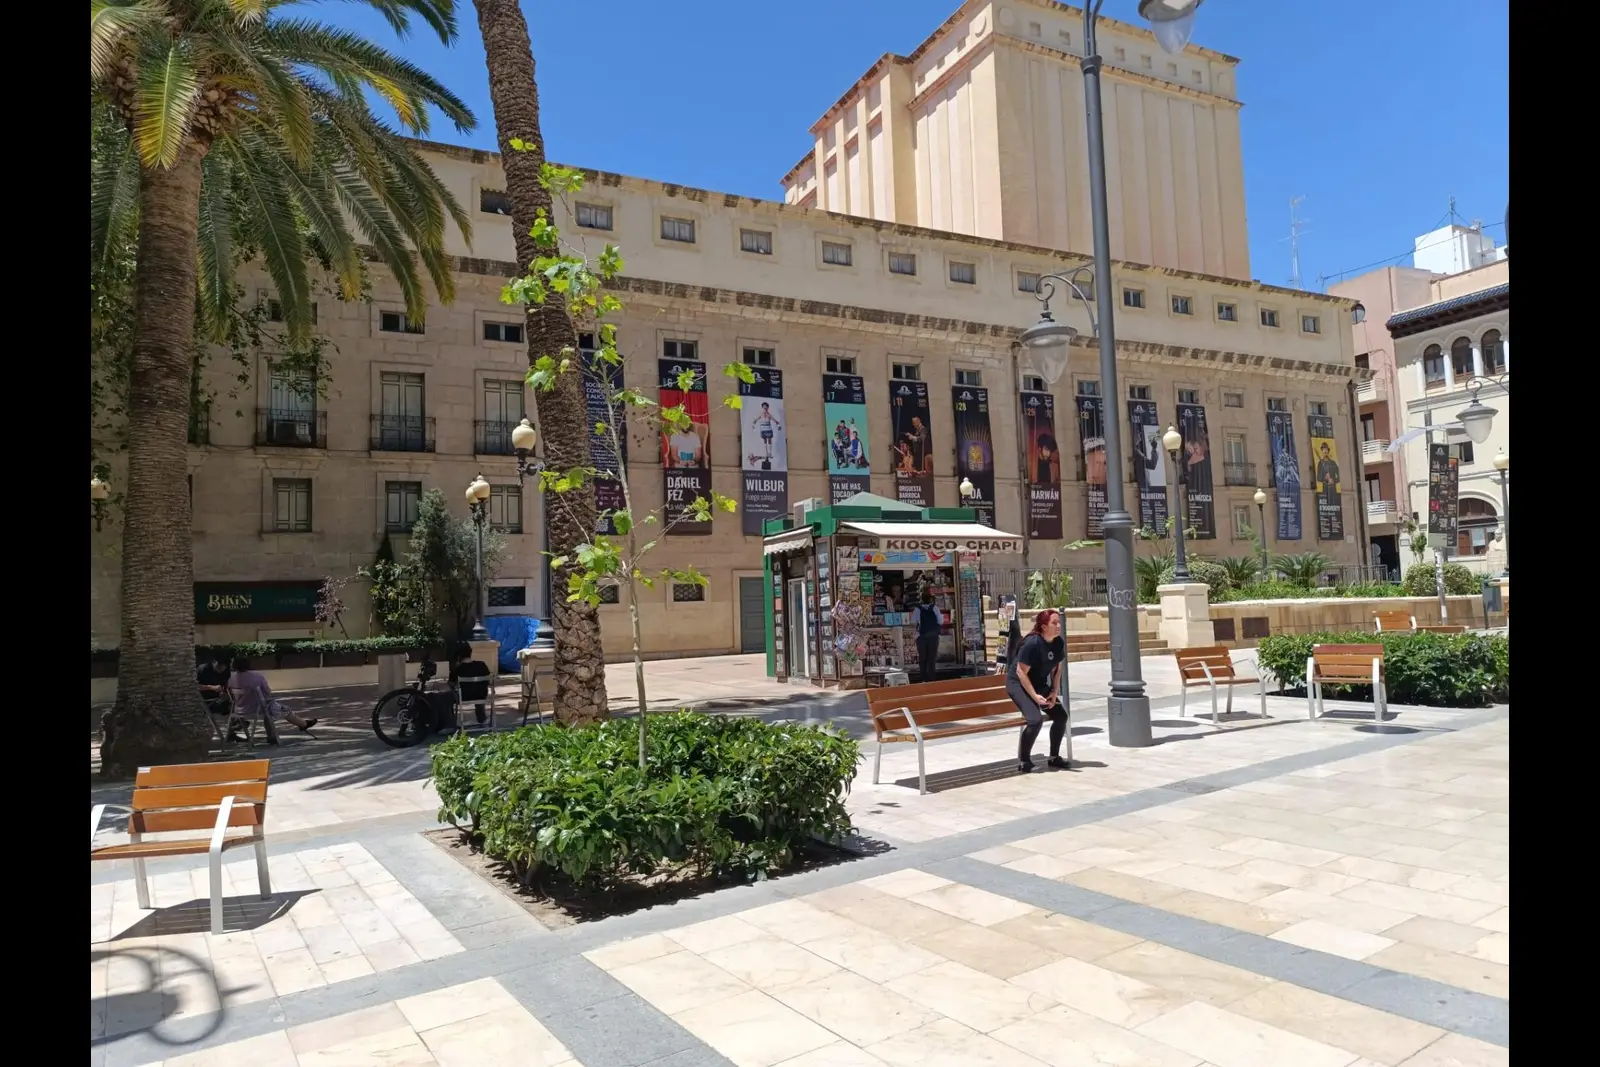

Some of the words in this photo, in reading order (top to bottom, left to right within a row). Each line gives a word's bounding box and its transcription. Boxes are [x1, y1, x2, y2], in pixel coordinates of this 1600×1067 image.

[667, 476, 701, 489] DANIEL
[745, 479, 785, 492] WILBUR
[667, 489, 684, 501] FEZ
[886, 540, 958, 550] KIOSCO
[966, 540, 1017, 550] CHAPI
